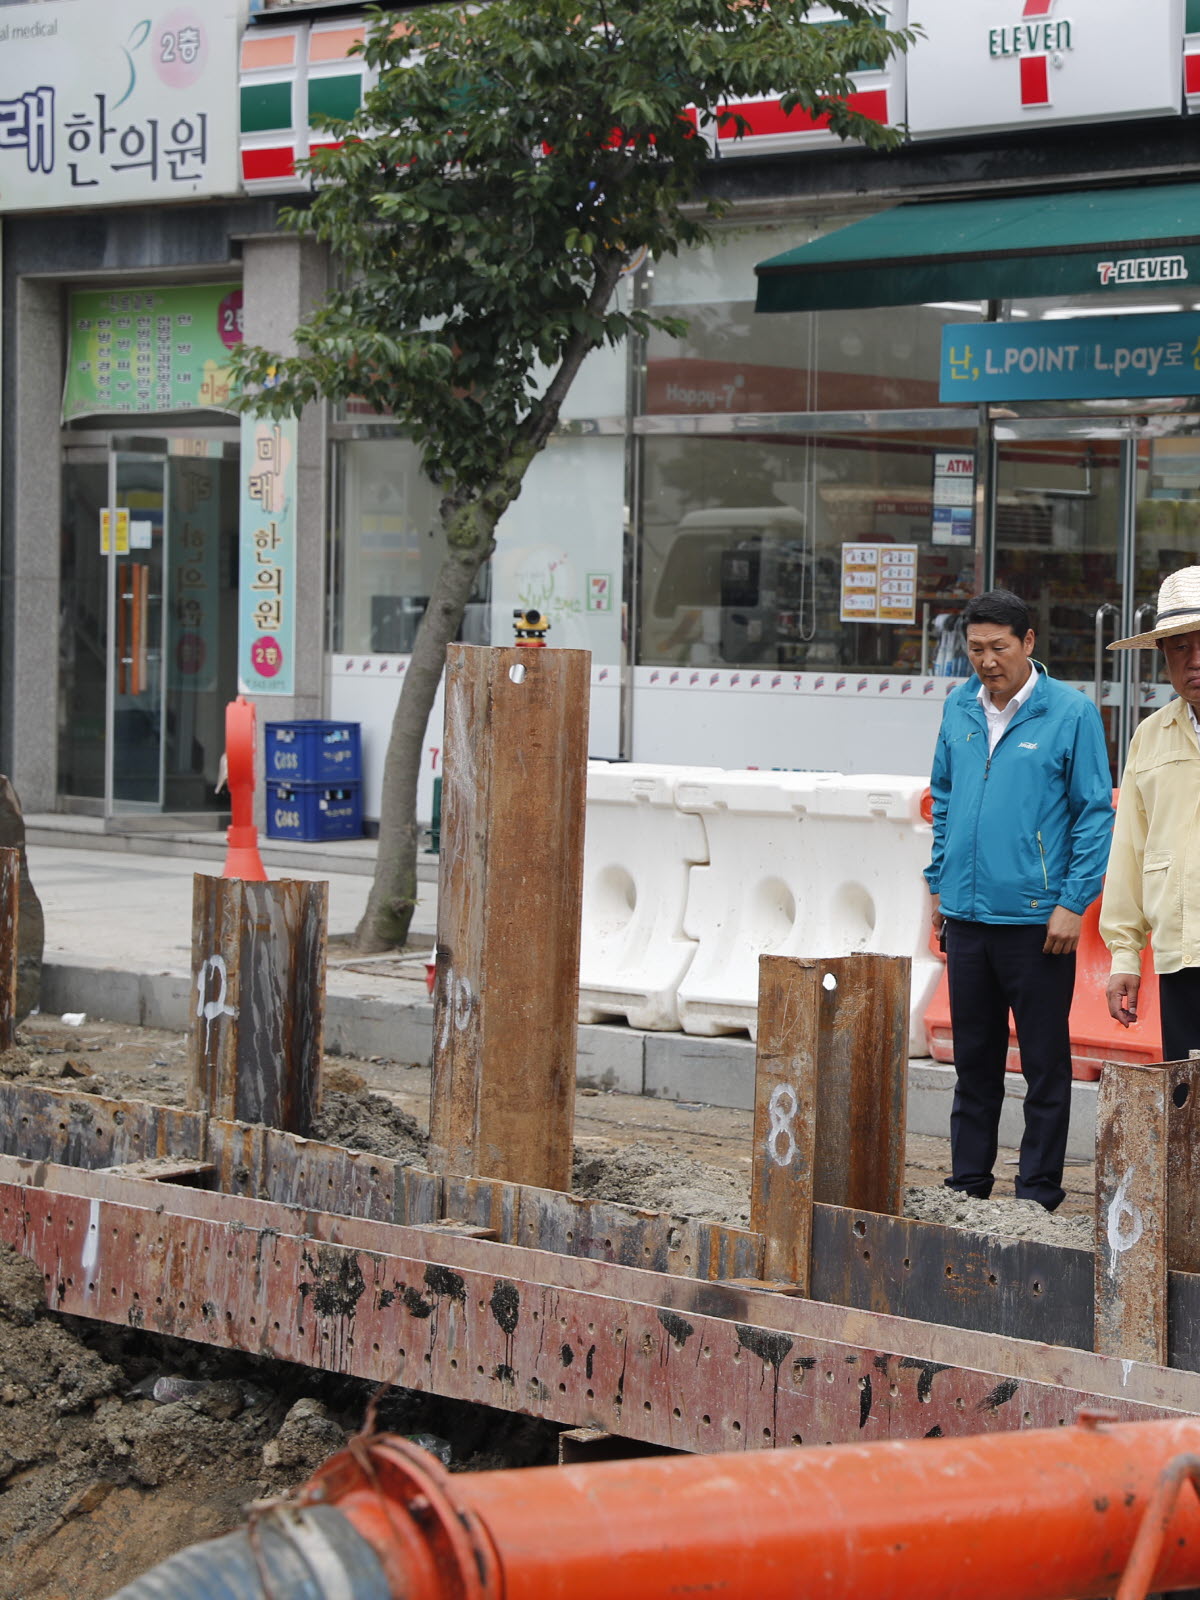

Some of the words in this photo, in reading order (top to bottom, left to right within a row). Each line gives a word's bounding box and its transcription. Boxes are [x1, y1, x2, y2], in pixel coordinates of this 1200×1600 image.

[12, 19, 57, 40] medical
[161, 27, 200, 63] 2층
[949, 345, 980, 380] 난,
[947, 460, 973, 473] ATM
[255, 647, 278, 664] 2층
[441, 967, 472, 1050] 10
[769, 1083, 798, 1167] 8
[1108, 1164, 1143, 1253] 6
